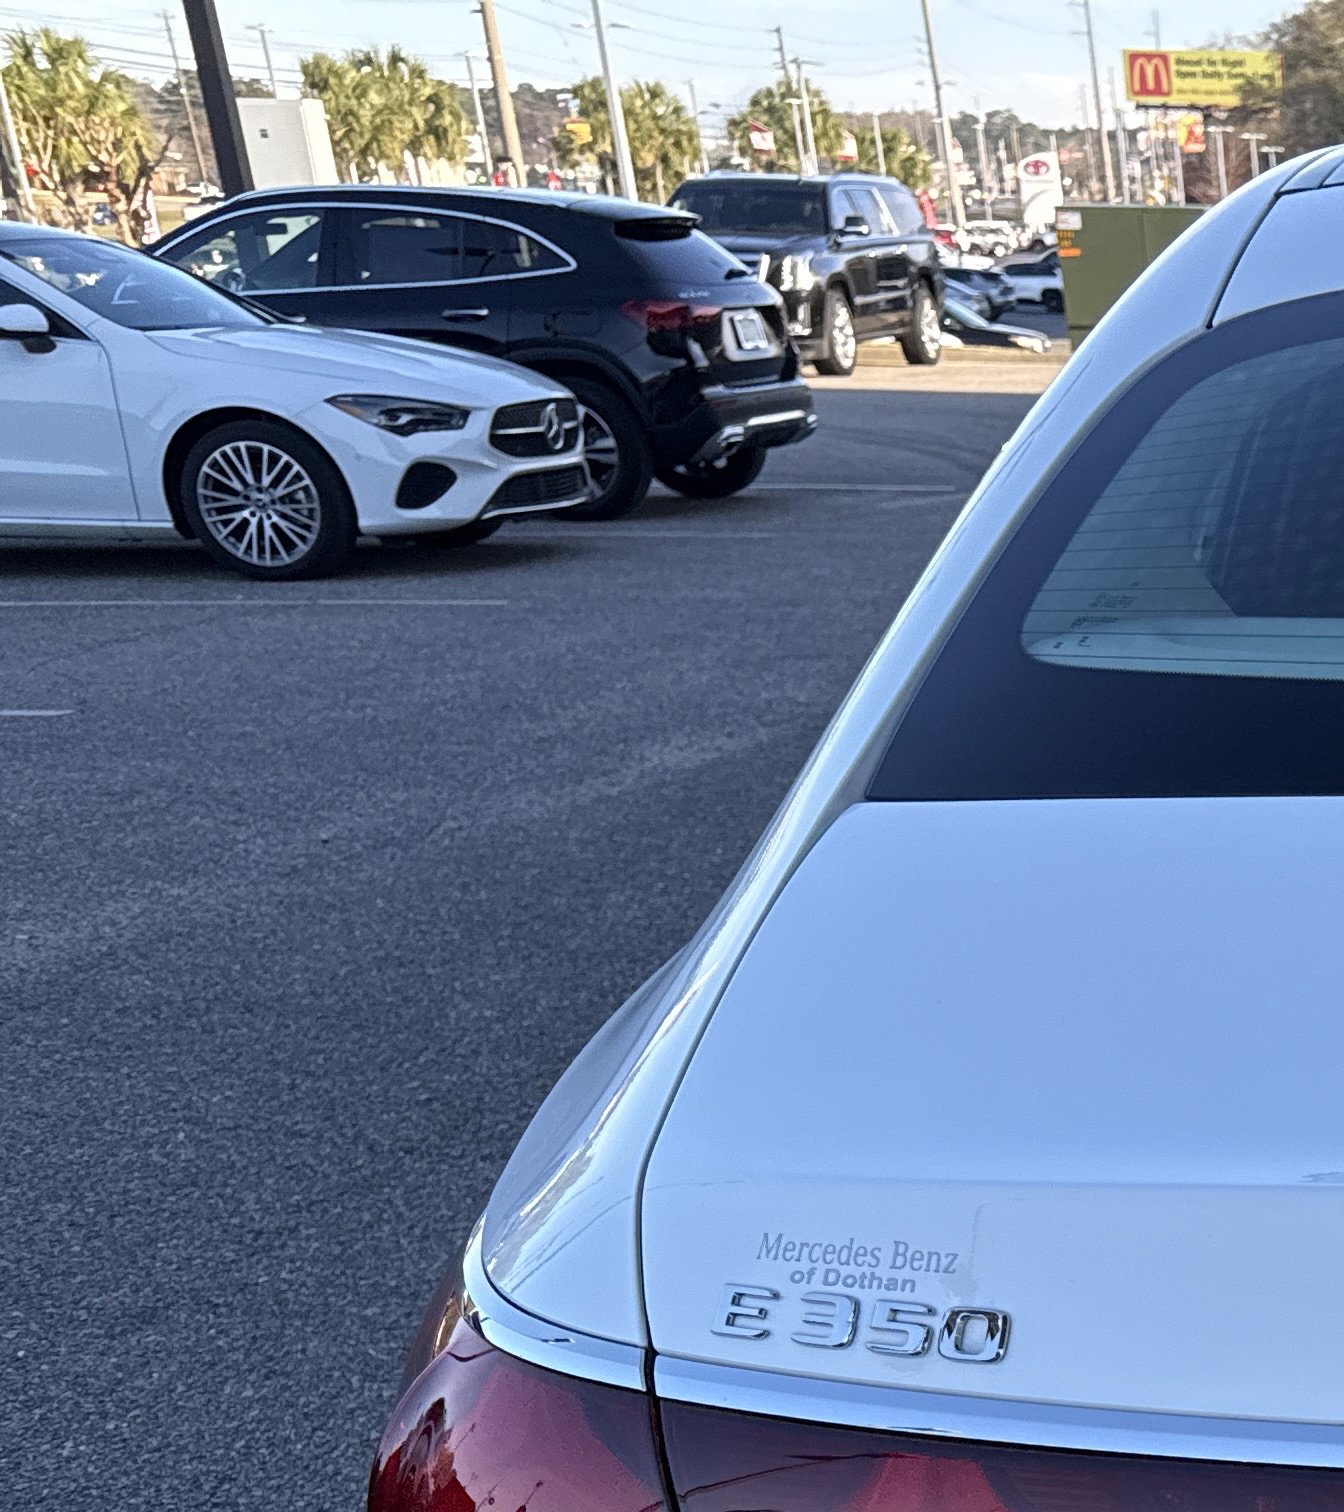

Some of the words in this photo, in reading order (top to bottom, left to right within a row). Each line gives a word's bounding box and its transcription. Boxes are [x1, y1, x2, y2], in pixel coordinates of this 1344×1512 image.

[756, 1232, 881, 1269] Mercedes
[889, 1240, 959, 1276] Benz
[789, 1266, 818, 1285] of
[822, 1267, 917, 1294] Dothan
[710, 1282, 781, 1340] E
[790, 1290, 1012, 1364] 350
